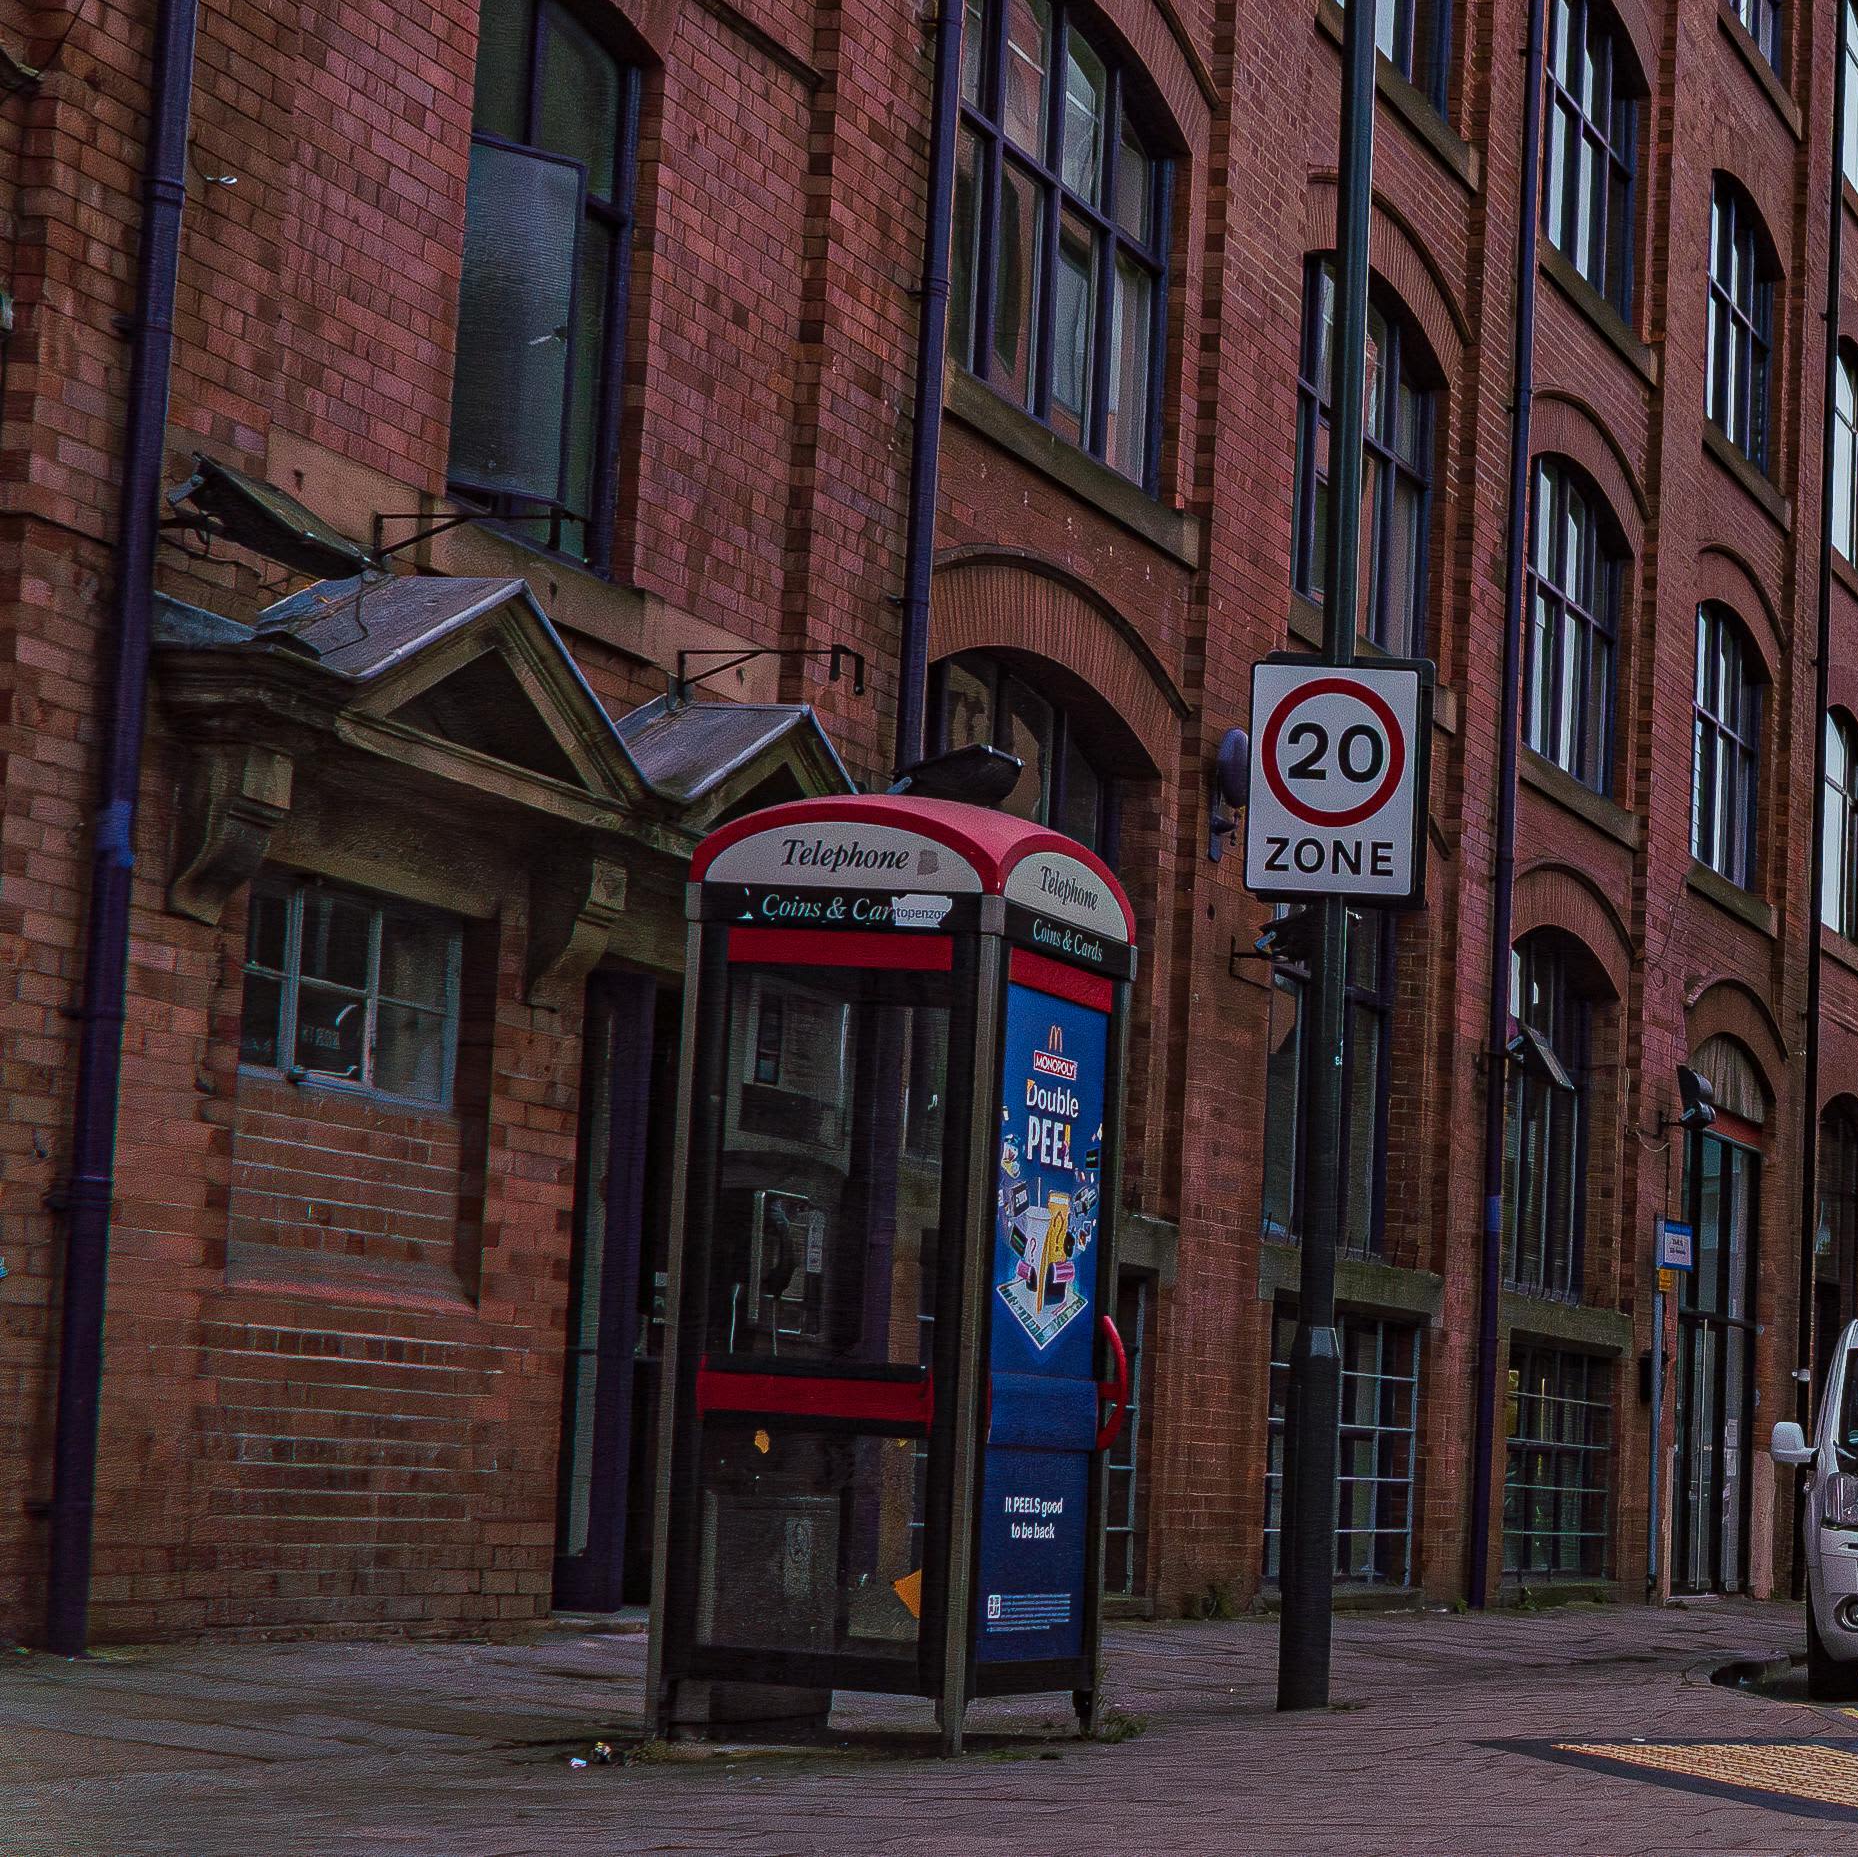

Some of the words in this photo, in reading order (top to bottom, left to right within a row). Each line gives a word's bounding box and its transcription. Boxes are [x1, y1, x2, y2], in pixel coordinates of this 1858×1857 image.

[1287, 721, 1384, 783] 20
[781, 838, 910, 873] Telephone
[1264, 836, 1394, 877] ZONE
[761, 893, 821, 918] Coins
[825, 896, 848, 918] &
[1039, 865, 1099, 912] Telephone
[1033, 919, 1061, 945] Coins
[1062, 930, 1073, 949] &
[1073, 933, 1104, 963] Cards
[1035, 1055, 1076, 1077] MONOPOLY
[1026, 1079, 1079, 1118] Double
[1026, 1115, 1073, 1170] PEEL
[1013, 1496, 1041, 1514] PEELS
[1041, 1497, 1064, 1518] good
[1011, 1522, 1021, 1539] to
[1021, 1522, 1033, 1539] be
[1034, 1522, 1055, 1539] back
